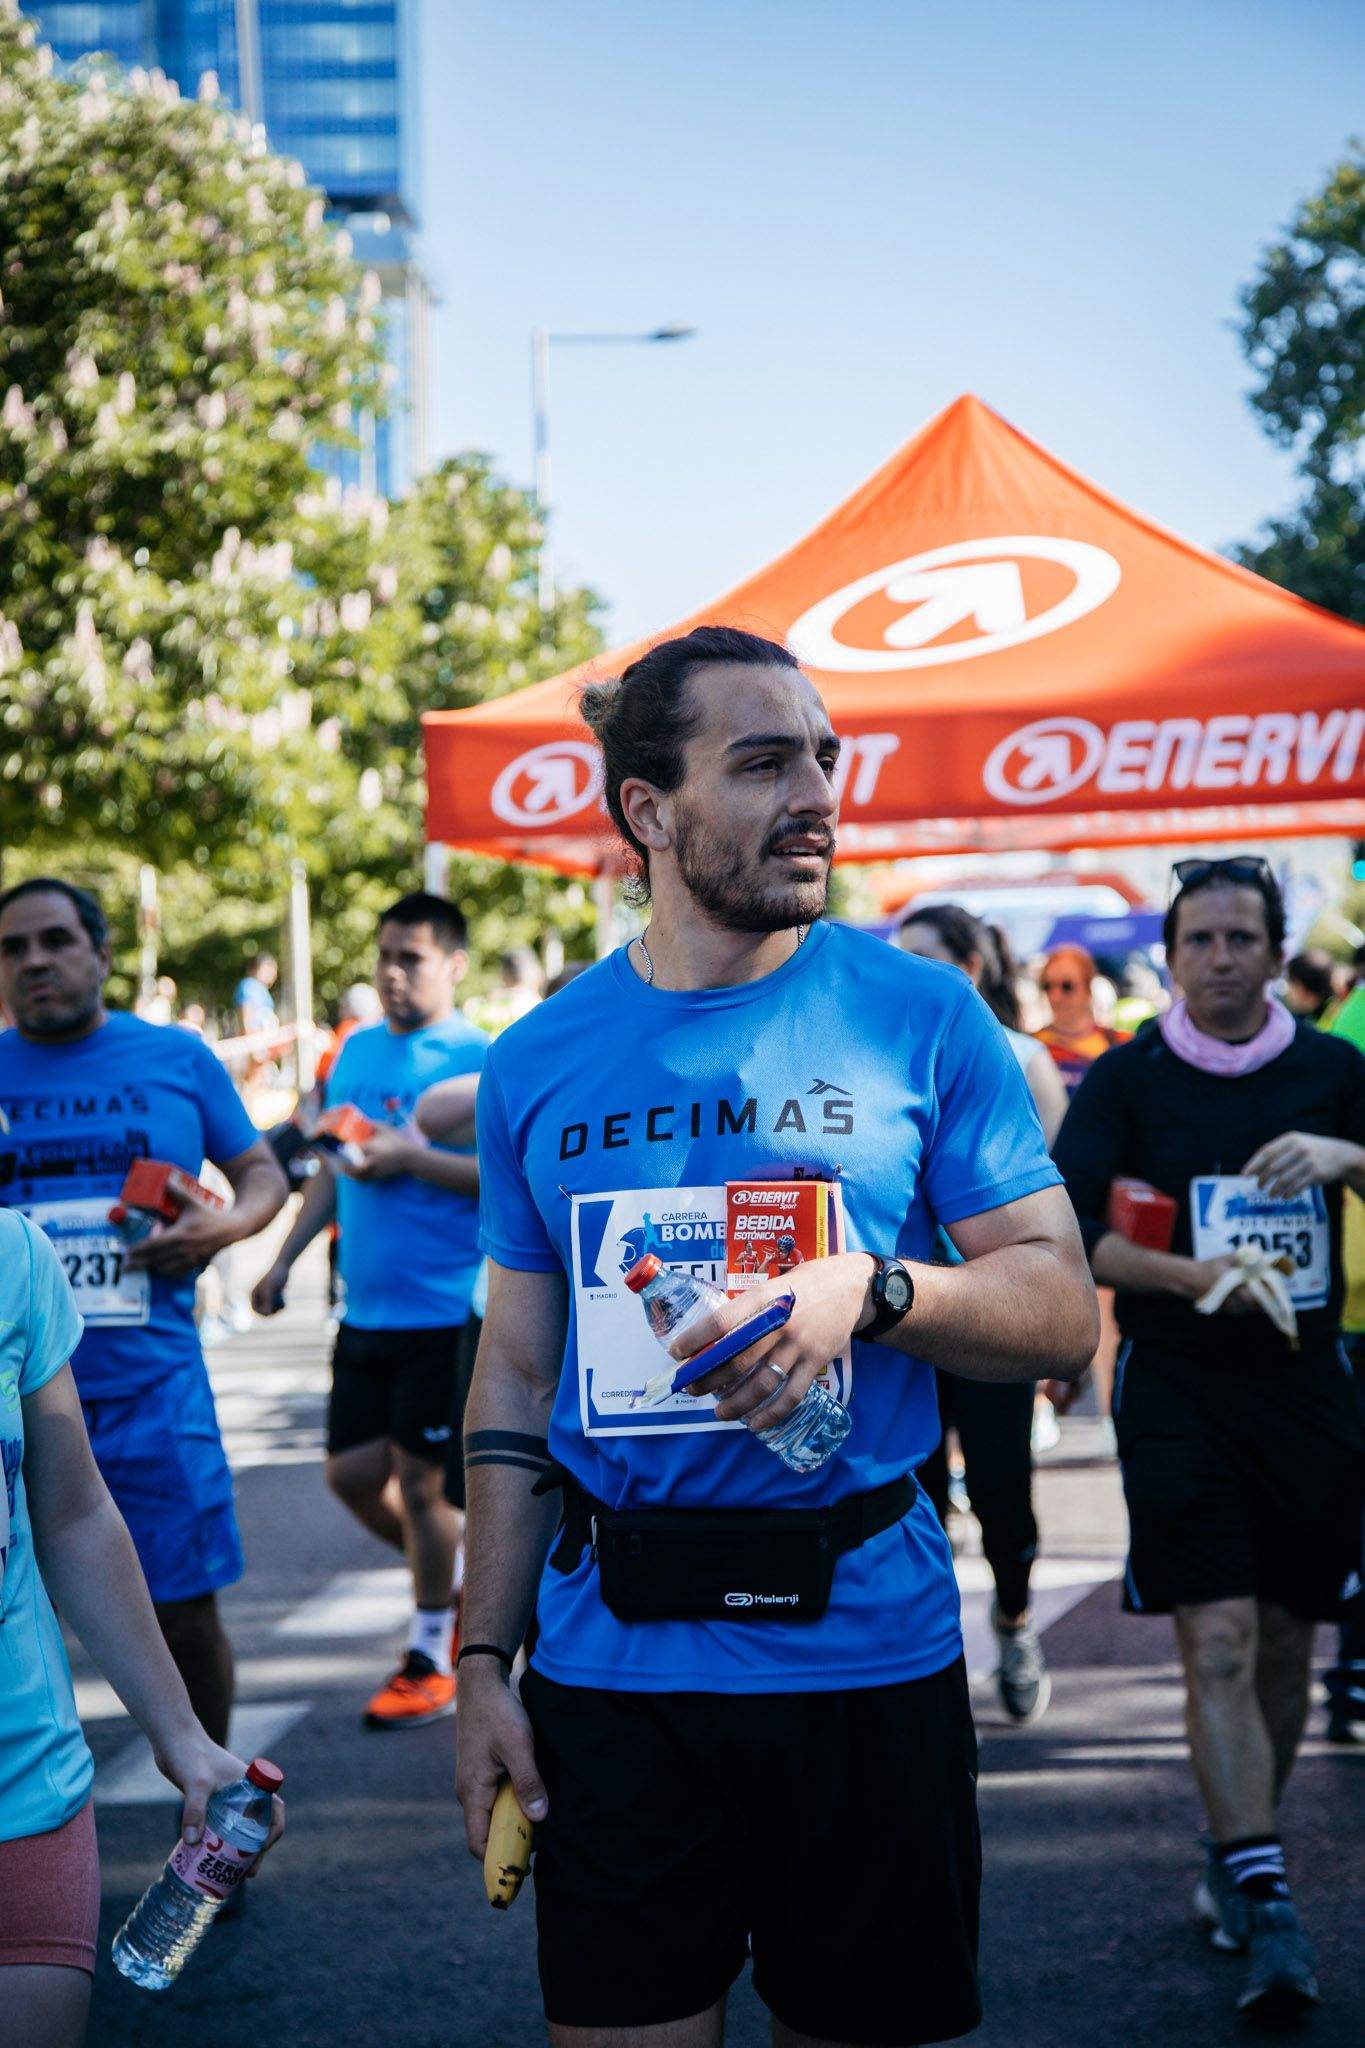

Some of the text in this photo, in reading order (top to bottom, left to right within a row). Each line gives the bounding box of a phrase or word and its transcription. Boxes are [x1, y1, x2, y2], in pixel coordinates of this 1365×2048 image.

[559, 1096, 854, 1162] DECIMAS
[750, 1191, 800, 1204] ENERVIT
[779, 1203, 797, 1211] Sport
[661, 1211, 708, 1222] CARRERA
[735, 1214, 796, 1231] BEBIDA
[754, 1594, 799, 1606] Kalenji
